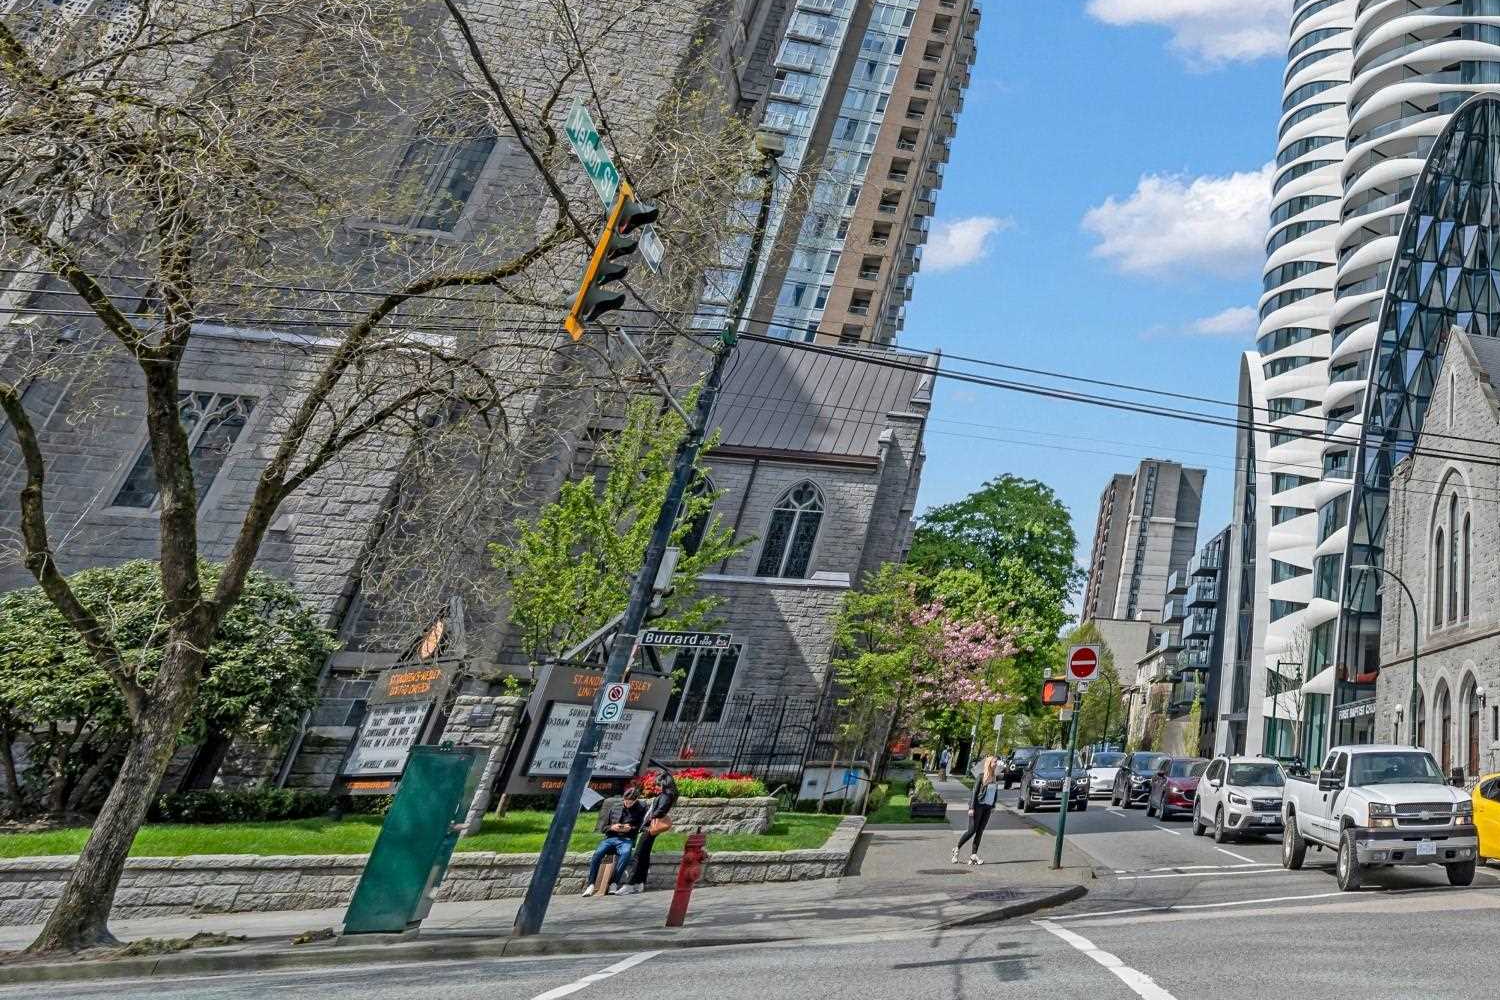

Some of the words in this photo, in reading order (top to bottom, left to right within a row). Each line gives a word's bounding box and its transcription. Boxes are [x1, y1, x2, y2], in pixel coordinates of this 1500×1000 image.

[571, 108, 600, 178] Nelson
[600, 166, 614, 197] St
[645, 632, 698, 645] Burrard
